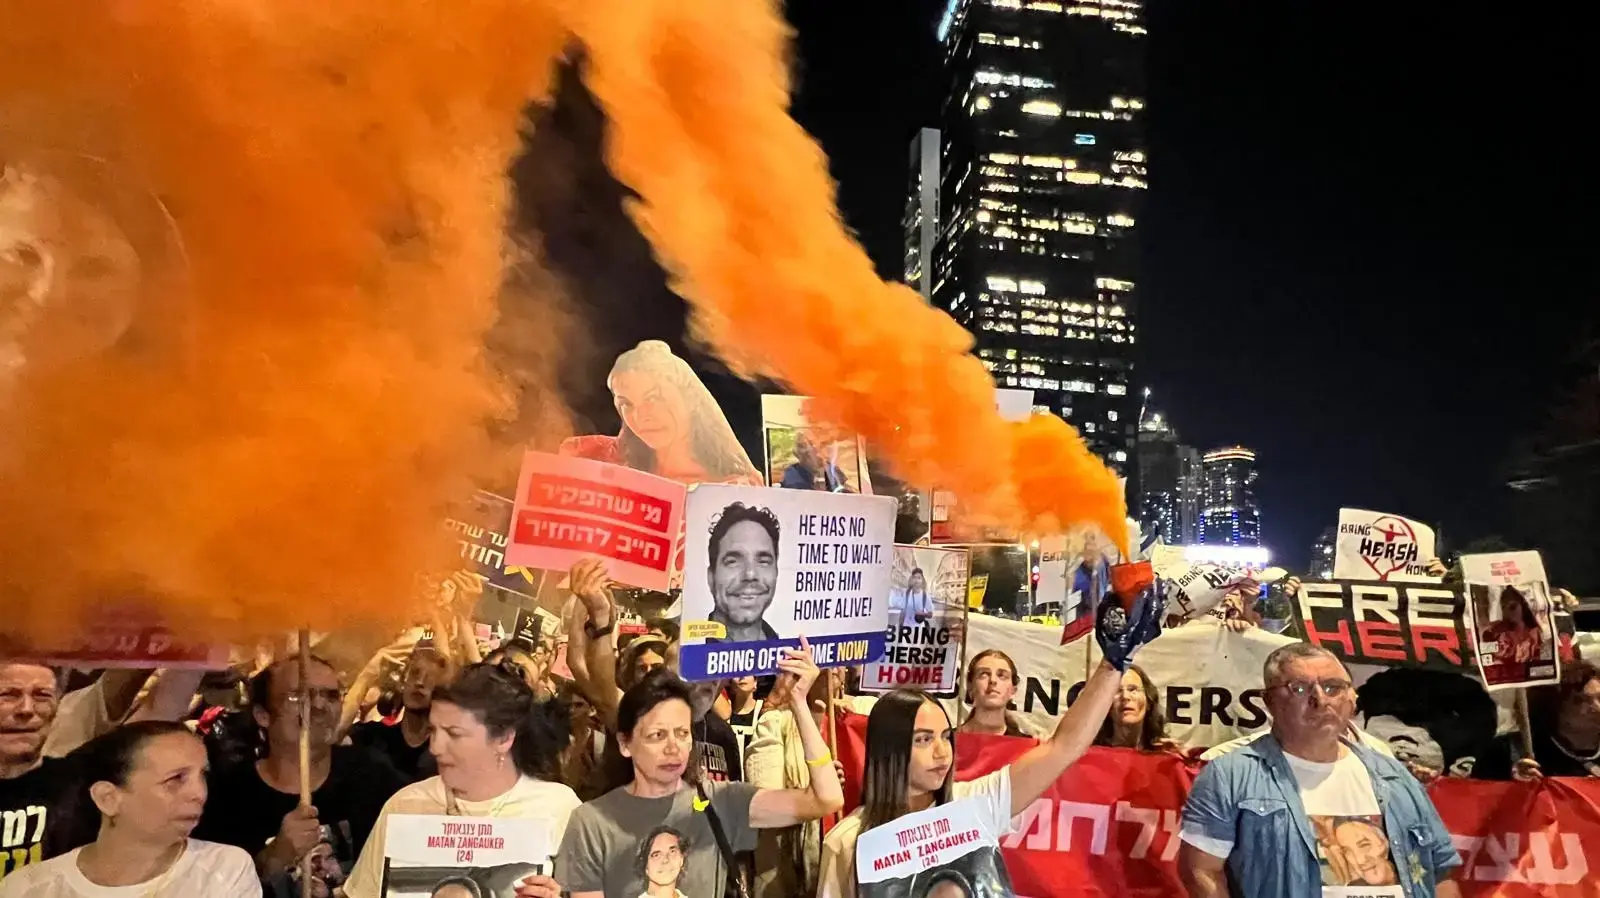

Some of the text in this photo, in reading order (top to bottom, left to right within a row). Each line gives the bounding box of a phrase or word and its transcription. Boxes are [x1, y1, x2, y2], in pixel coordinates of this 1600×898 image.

[540, 482, 662, 525] מי שהפקיר
[799, 514, 866, 537] HE HAS NO
[525, 517, 661, 561] חייב להחזיר
[1359, 537, 1418, 562] HERSH
[455, 540, 504, 569] חוזר
[797, 543, 882, 564] TIME TO WAIT.
[795, 571, 862, 592] BRING HIM
[1405, 563, 1431, 577] HOM
[793, 597, 872, 621] HOME ALIVE!
[1208, 608, 1225, 620] OME
[1299, 582, 1470, 628] FRE
[886, 624, 950, 645] BRING
[1303, 619, 1478, 666] HER
[706, 649, 755, 675] BRING
[836, 639, 869, 662] NOW!
[881, 645, 947, 665] HERSH
[878, 665, 945, 685] HOME
[0, 804, 47, 848] למ
[427, 836, 505, 849] MATAN ZANGAUKER
[873, 829, 981, 871] MATAN ZANGAUKER
[456, 849, 474, 863] (24)
[921, 853, 939, 868] (24)
